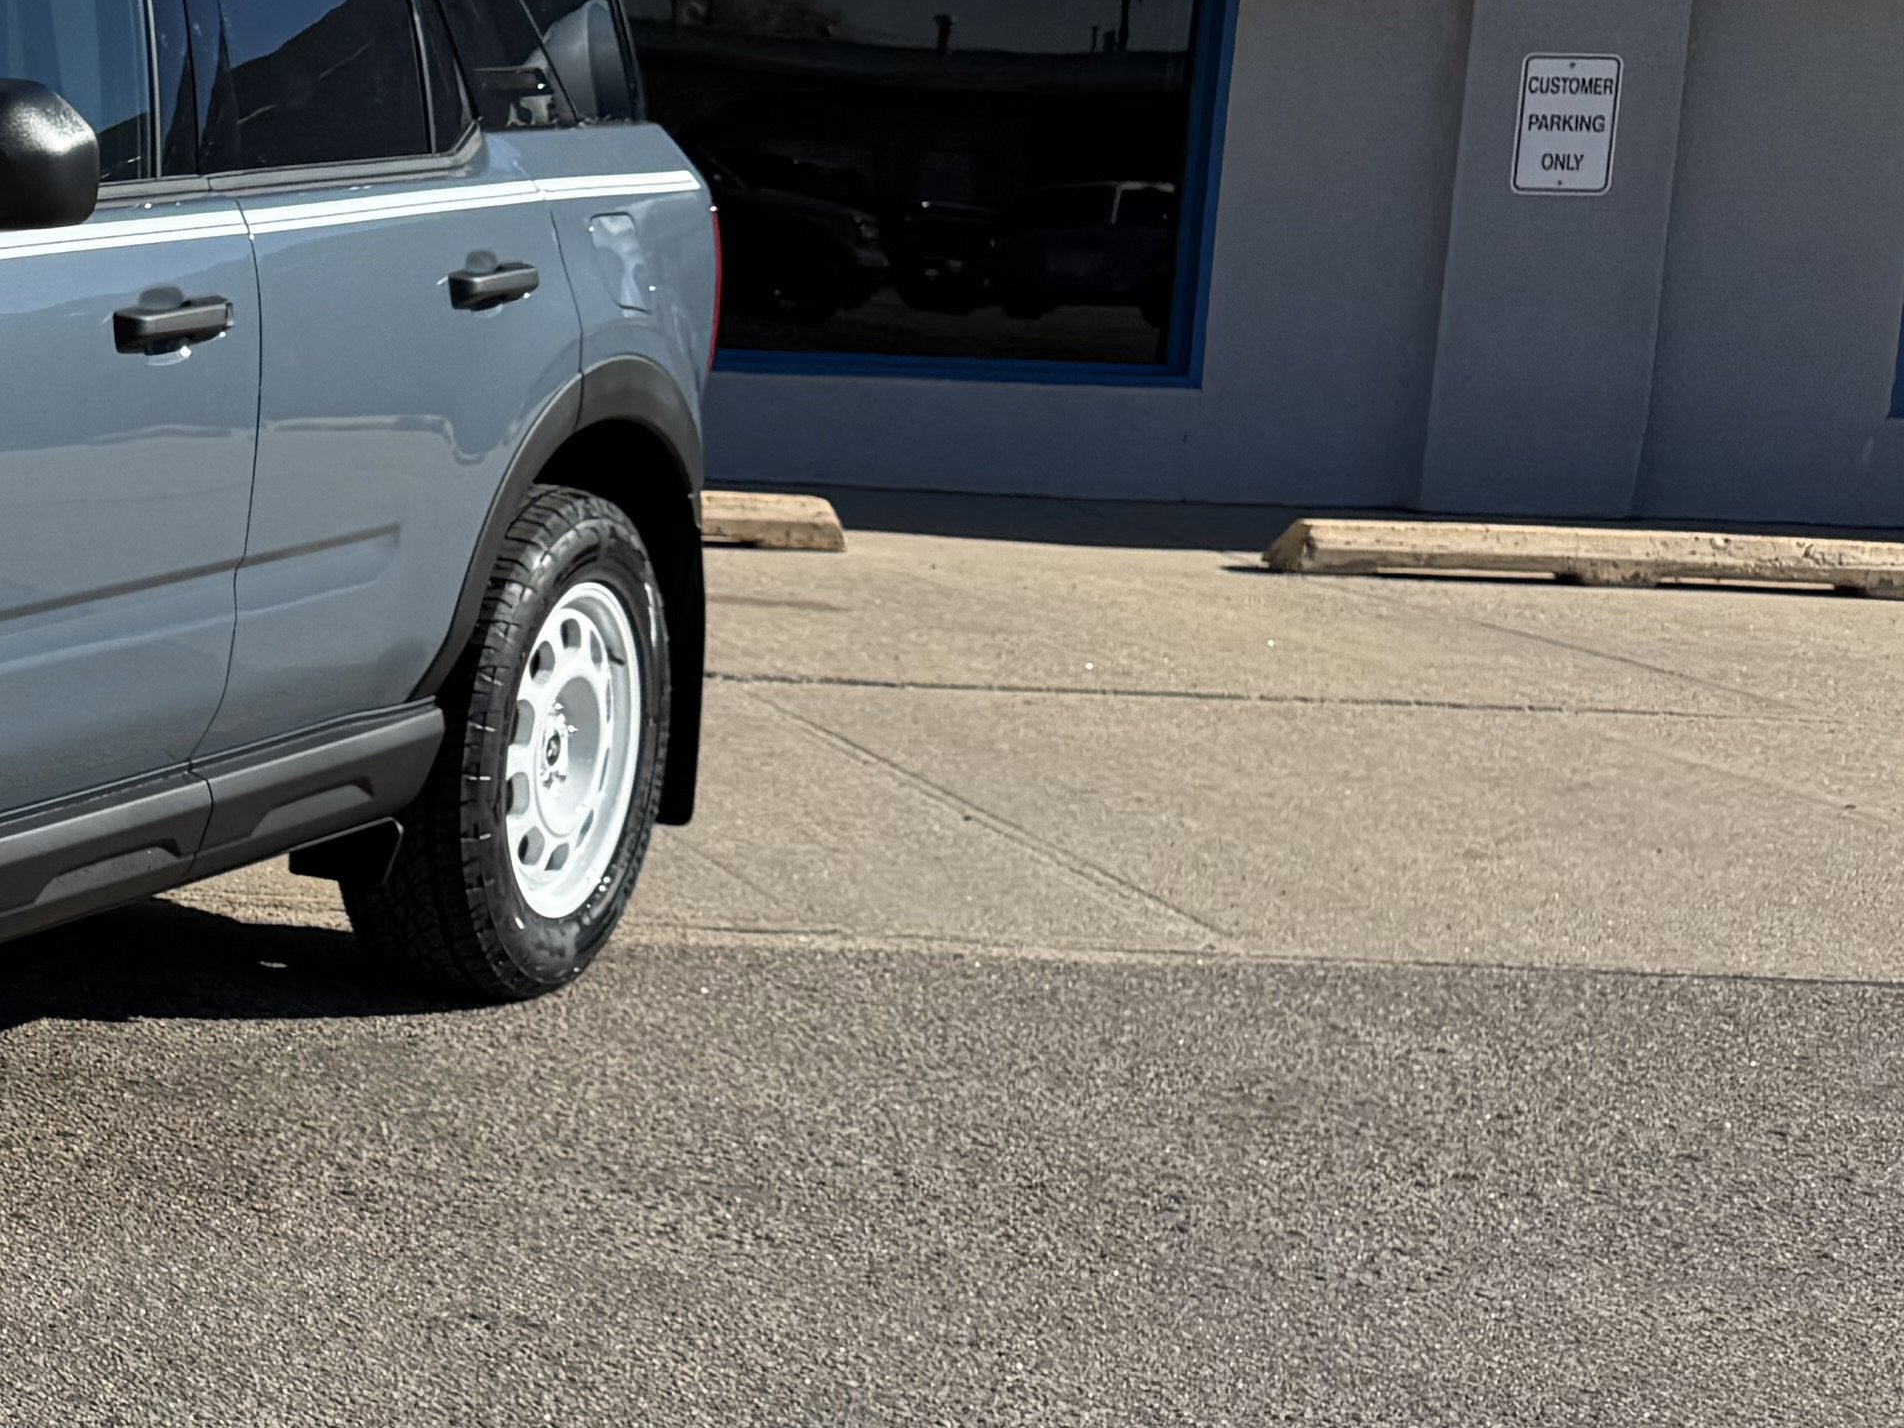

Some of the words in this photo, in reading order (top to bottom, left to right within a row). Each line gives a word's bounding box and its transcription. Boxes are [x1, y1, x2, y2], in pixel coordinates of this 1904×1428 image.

[1528, 76, 1614, 96] CUSTOMER
[1527, 113, 1606, 133] PARKING
[1541, 152, 1584, 172] ONLY
